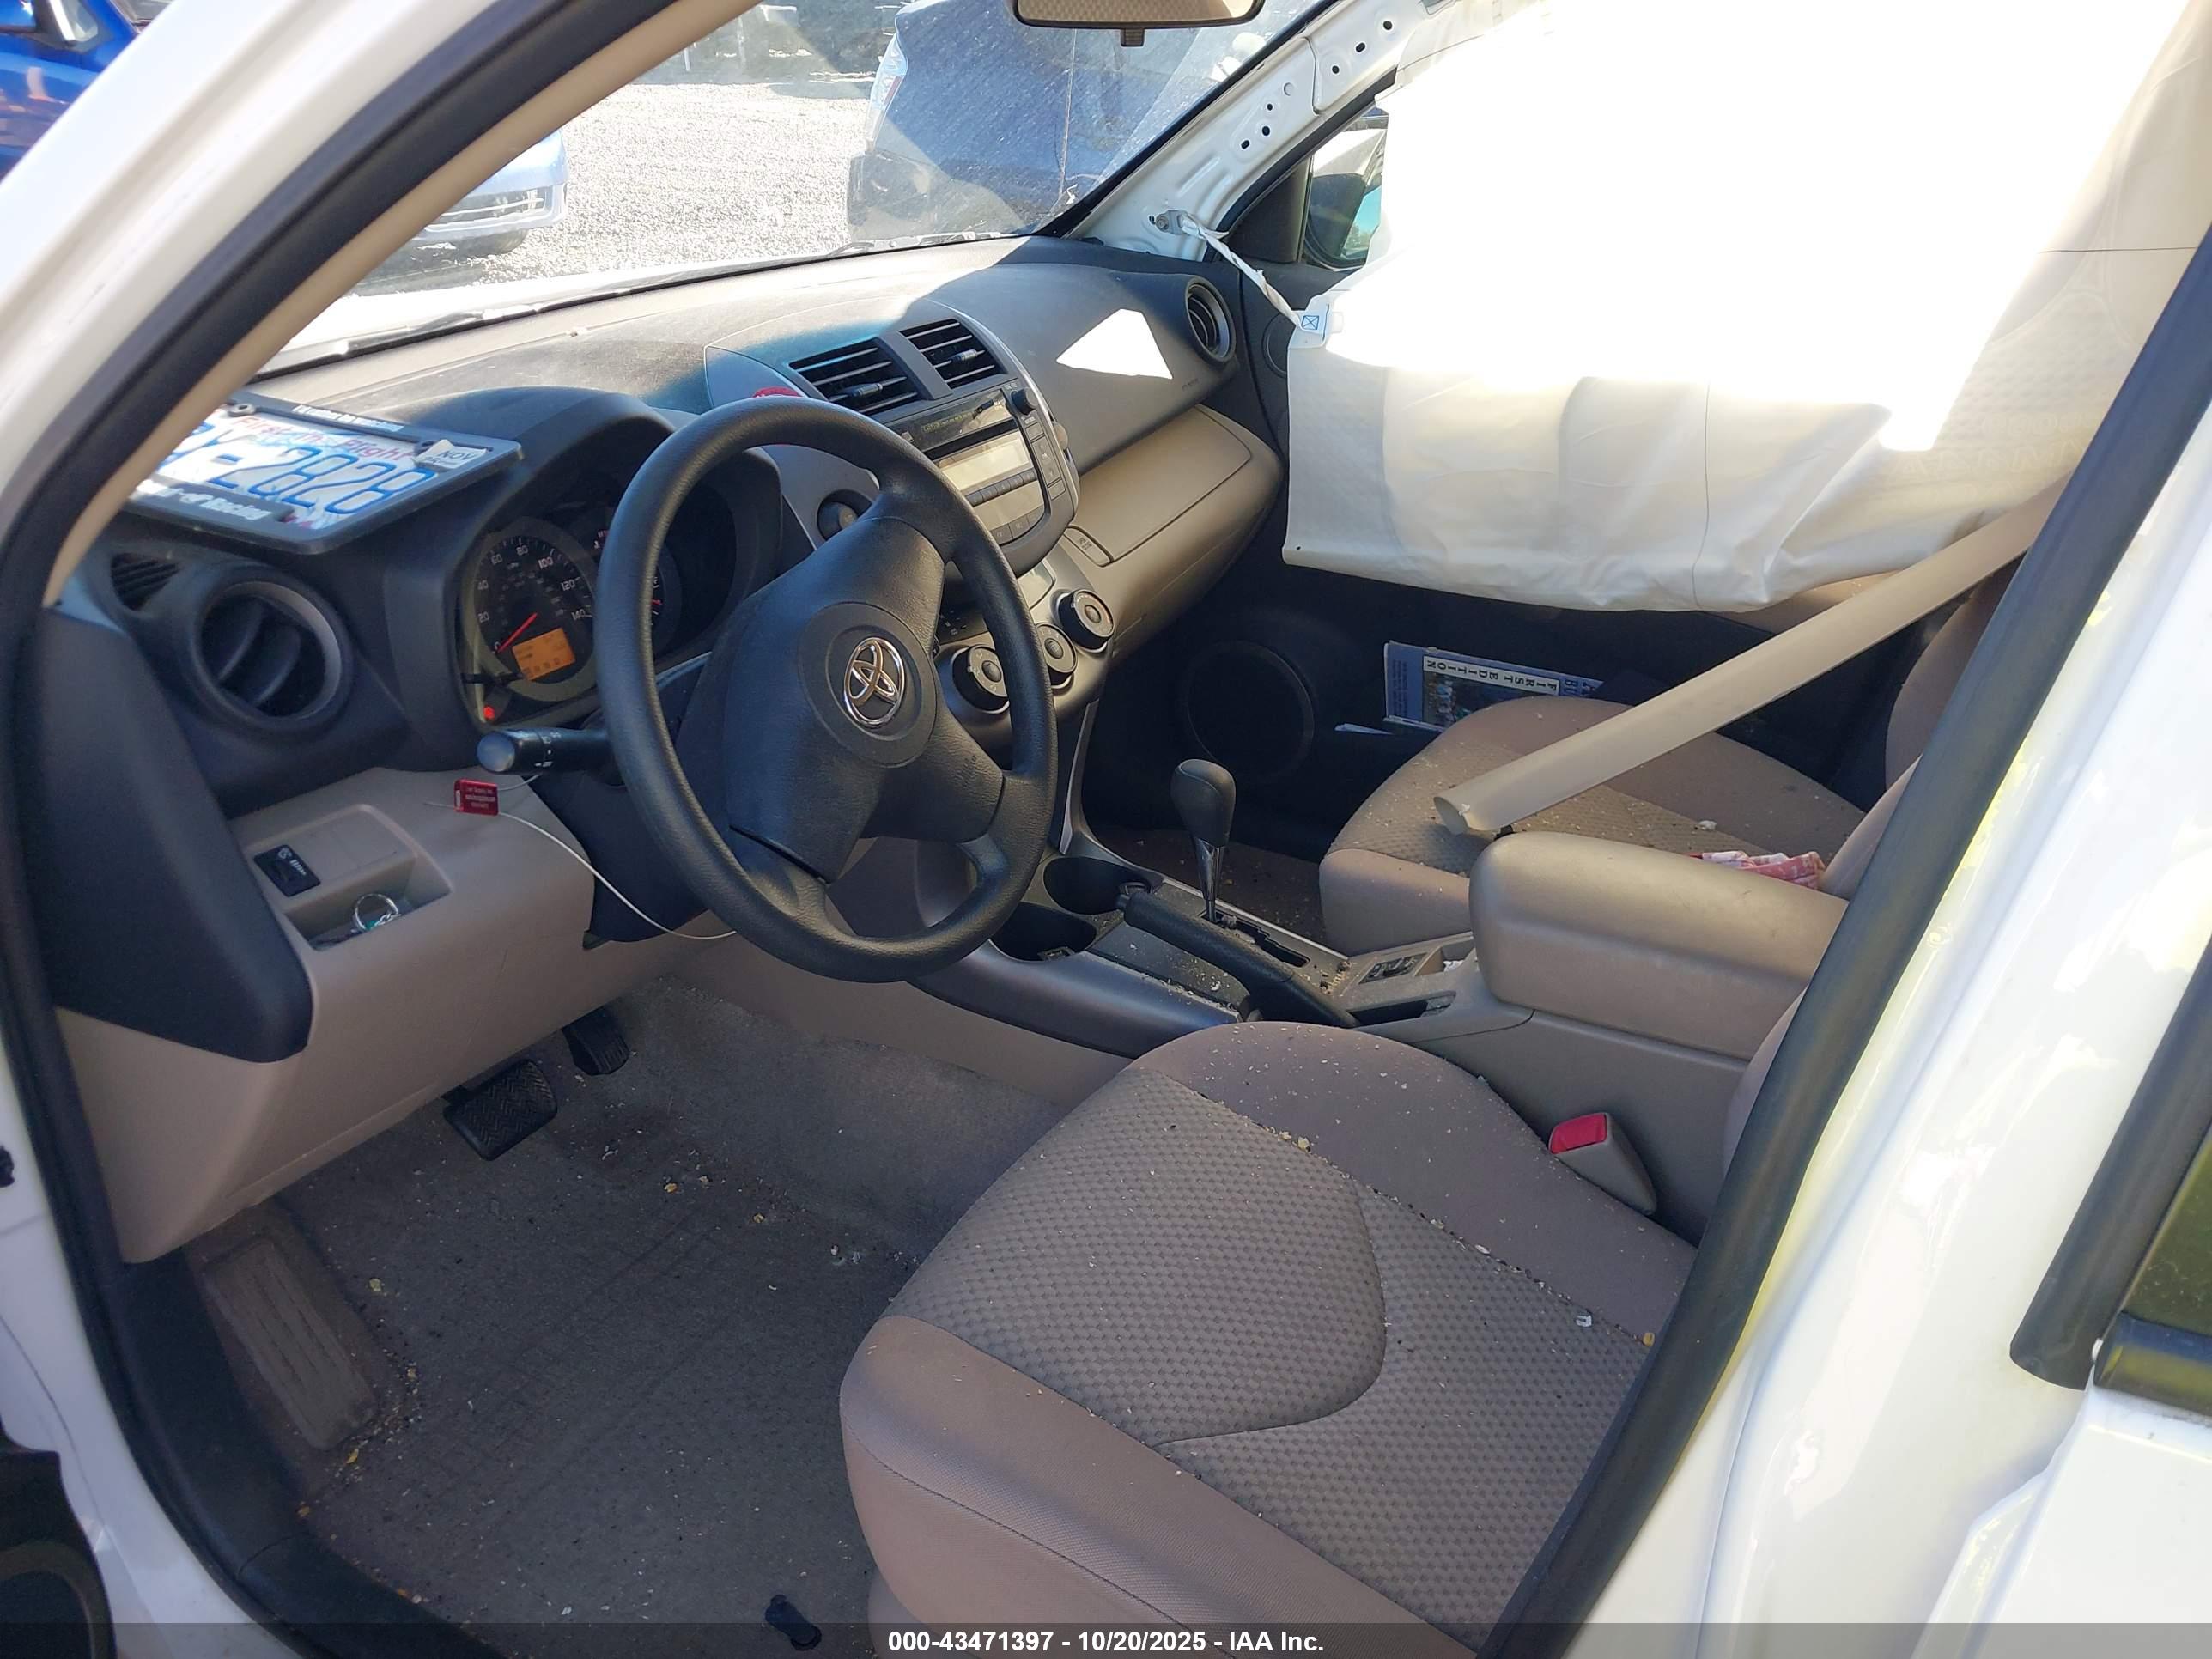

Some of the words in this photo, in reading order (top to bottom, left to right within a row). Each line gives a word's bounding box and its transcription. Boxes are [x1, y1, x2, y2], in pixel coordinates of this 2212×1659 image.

[233, 417, 296, 435] First
[340, 438, 413, 461] Flight
[436, 450, 477, 461] NOV
[516, 545, 528, 556] 80
[491, 554, 503, 565] 60
[538, 556, 554, 569] 100
[477, 580, 489, 591] 40
[561, 579, 575, 591] 120
[477, 611, 489, 623] 20
[571, 608, 586, 620] 140
[1426, 659, 1498, 681] EDITION
[1504, 676, 1558, 691] FIRST
